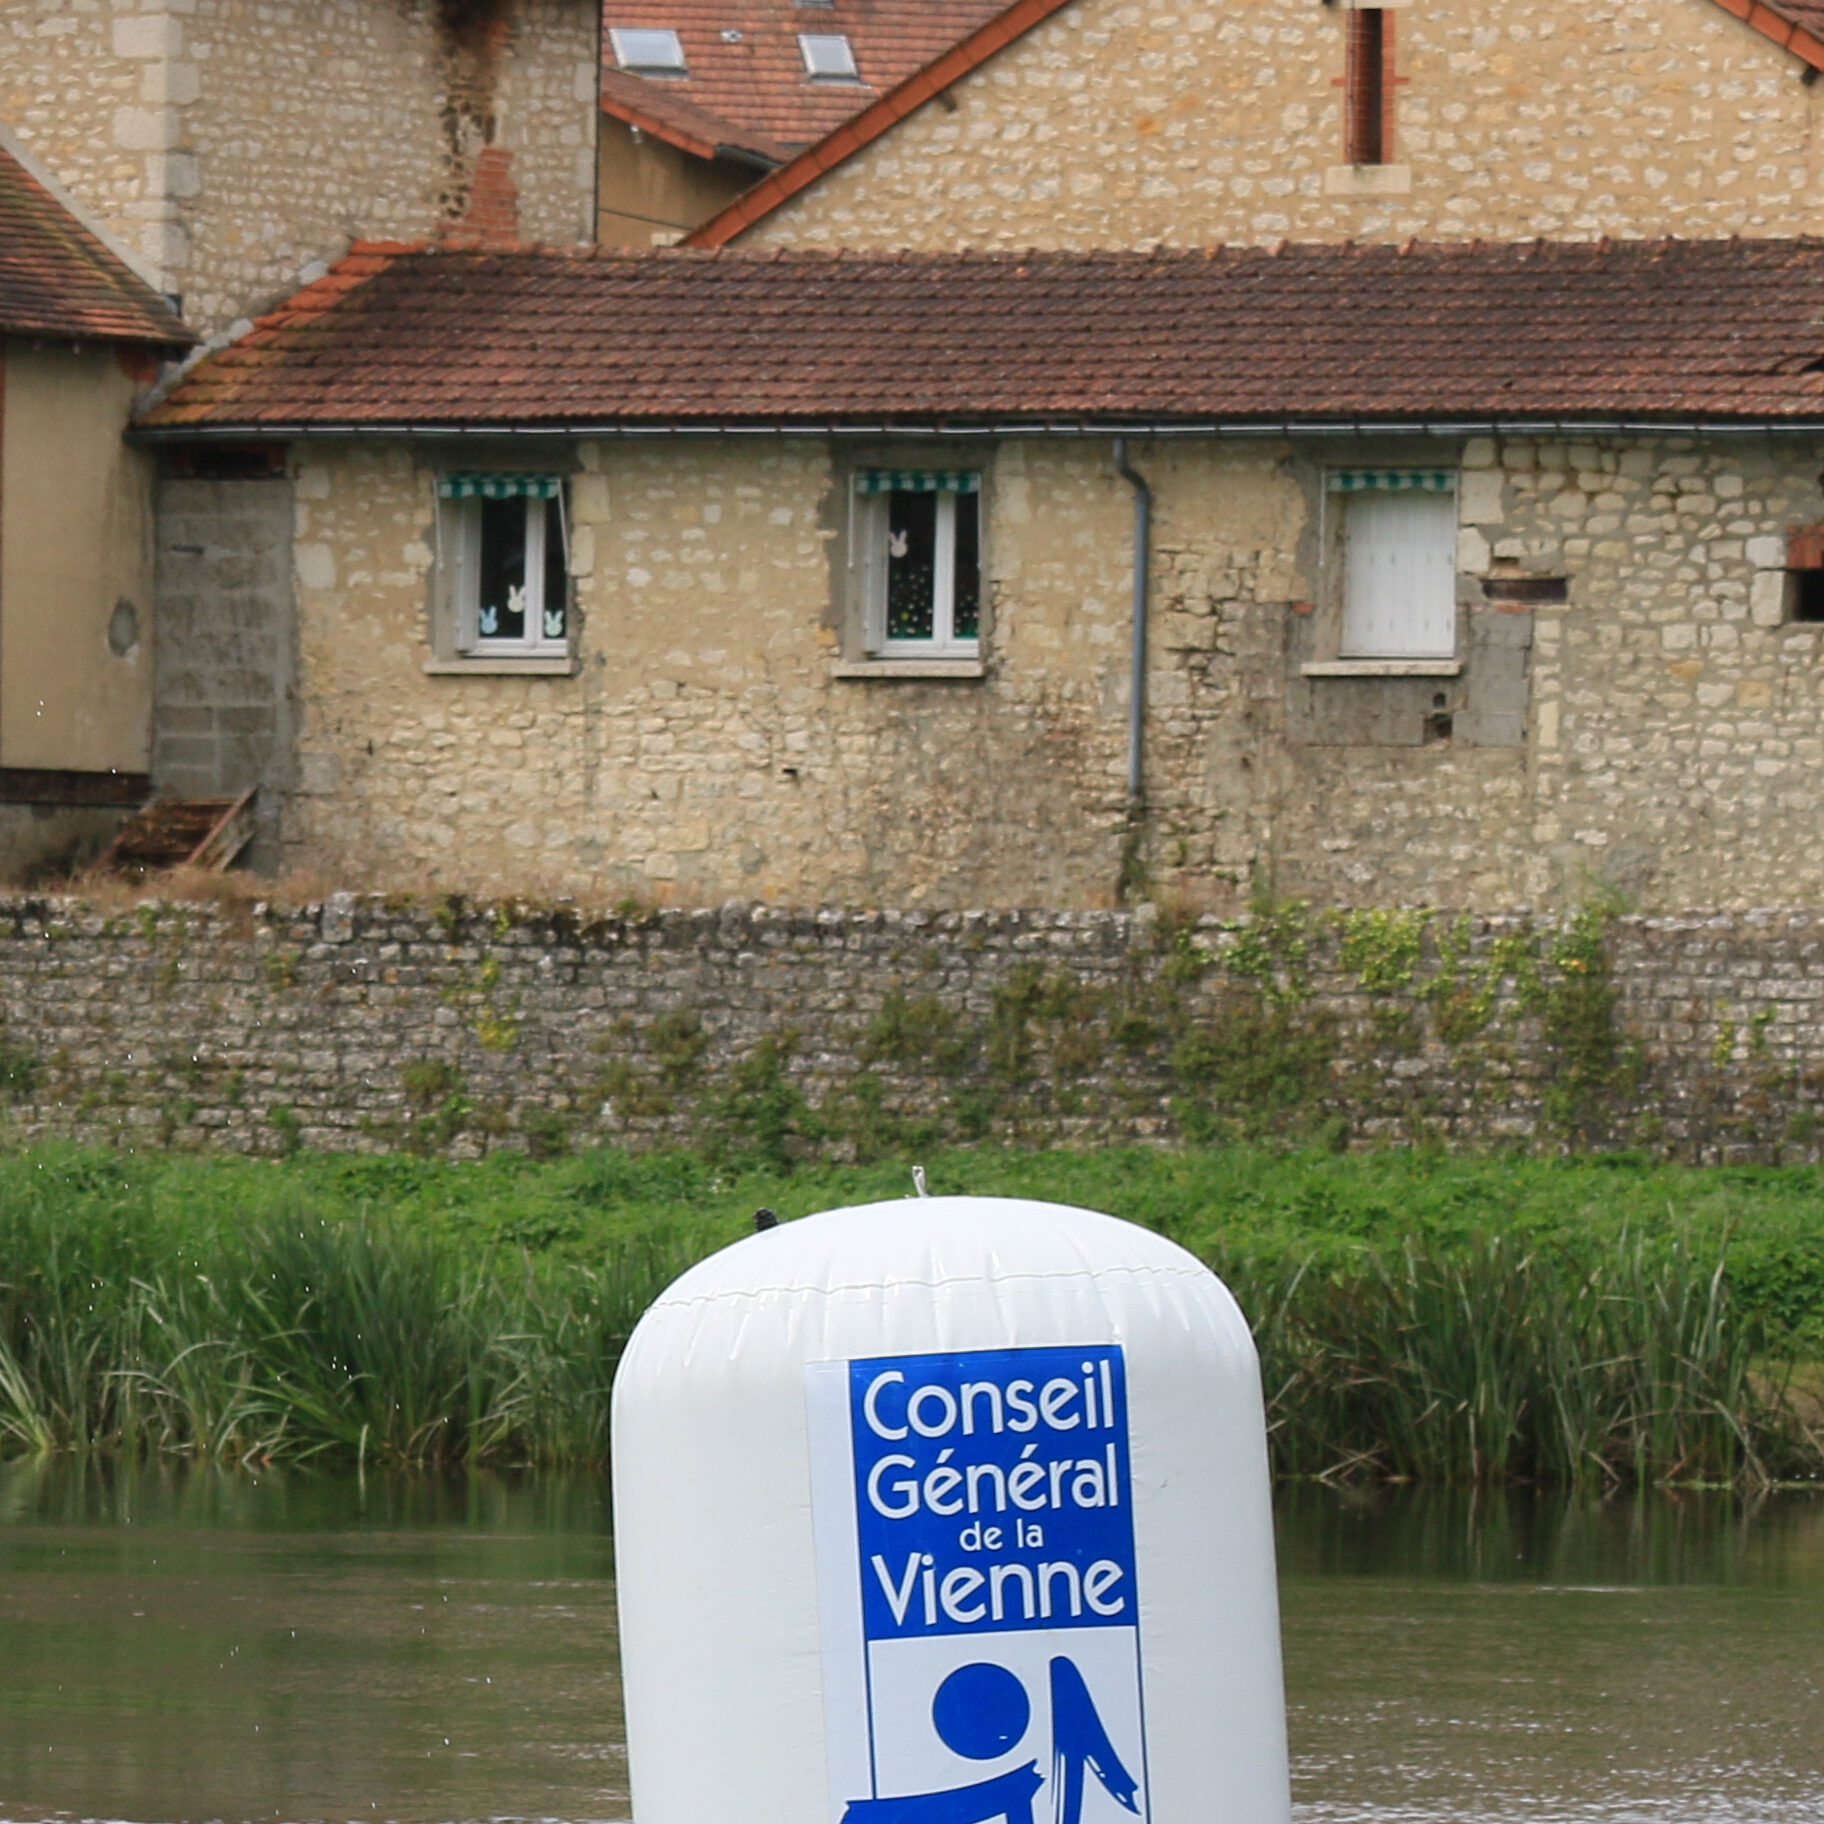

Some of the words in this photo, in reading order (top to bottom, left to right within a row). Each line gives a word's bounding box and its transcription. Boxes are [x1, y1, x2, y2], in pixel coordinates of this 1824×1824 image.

[863, 1359, 1114, 1440] Conseil
[867, 1443, 1119, 1519] Général
[959, 1521, 1002, 1551] de
[1016, 1518, 1044, 1548] la
[871, 1551, 1125, 1627] Vienne
